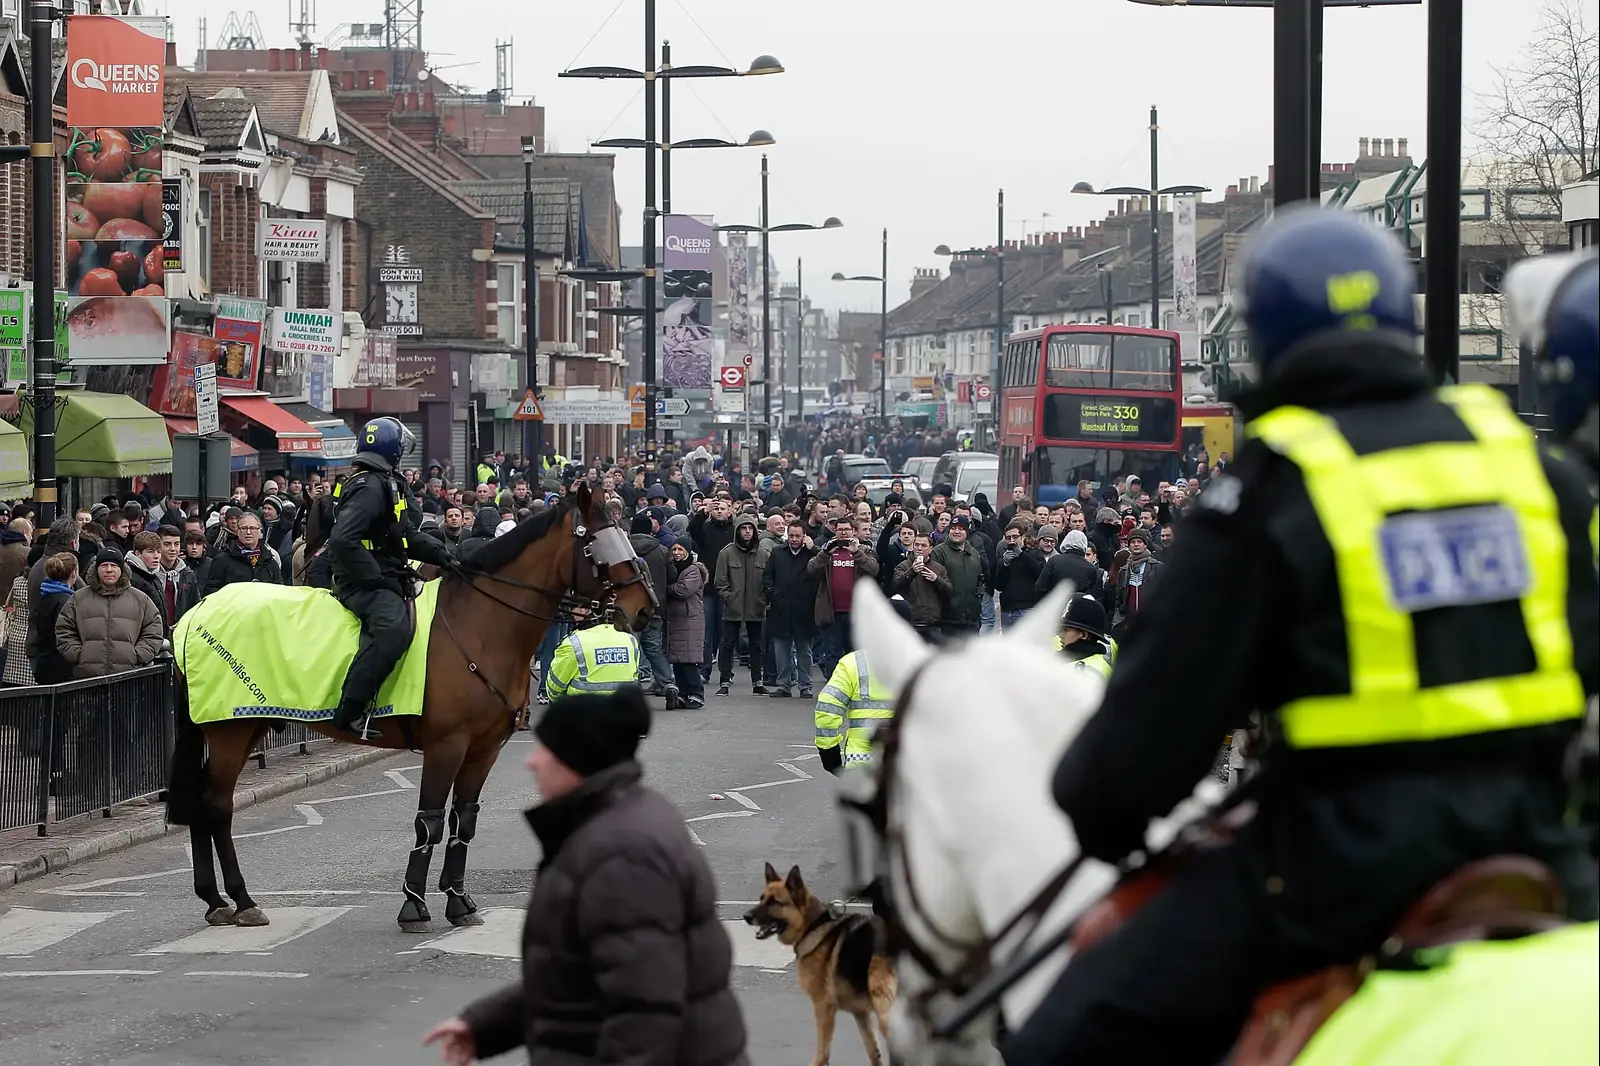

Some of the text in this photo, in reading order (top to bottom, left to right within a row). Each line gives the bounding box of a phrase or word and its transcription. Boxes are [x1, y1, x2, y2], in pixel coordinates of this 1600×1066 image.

[71, 58, 160, 93] QUEENS
[112, 83, 159, 94] MARKET
[268, 224, 318, 239] Kiran
[666, 235, 711, 252] QUEENS
[284, 311, 333, 328] UMMAH
[289, 325, 326, 334] HALAL MEAT
[403, 326, 413, 334] DO
[415, 326, 422, 334] IT
[288, 332, 320, 342] GROCERIES
[321, 335, 333, 343] LTD
[276, 340, 289, 349] TEL:
[290, 342, 306, 350] 0208
[307, 343, 319, 351] 472
[744, 355, 751, 366] C
[522, 405, 536, 414] 101
[1113, 405, 1139, 419] 330
[366, 424, 379, 433] MP
[1081, 422, 1139, 432] Wanstead Park Station
[597, 653, 628, 663] POLICE
